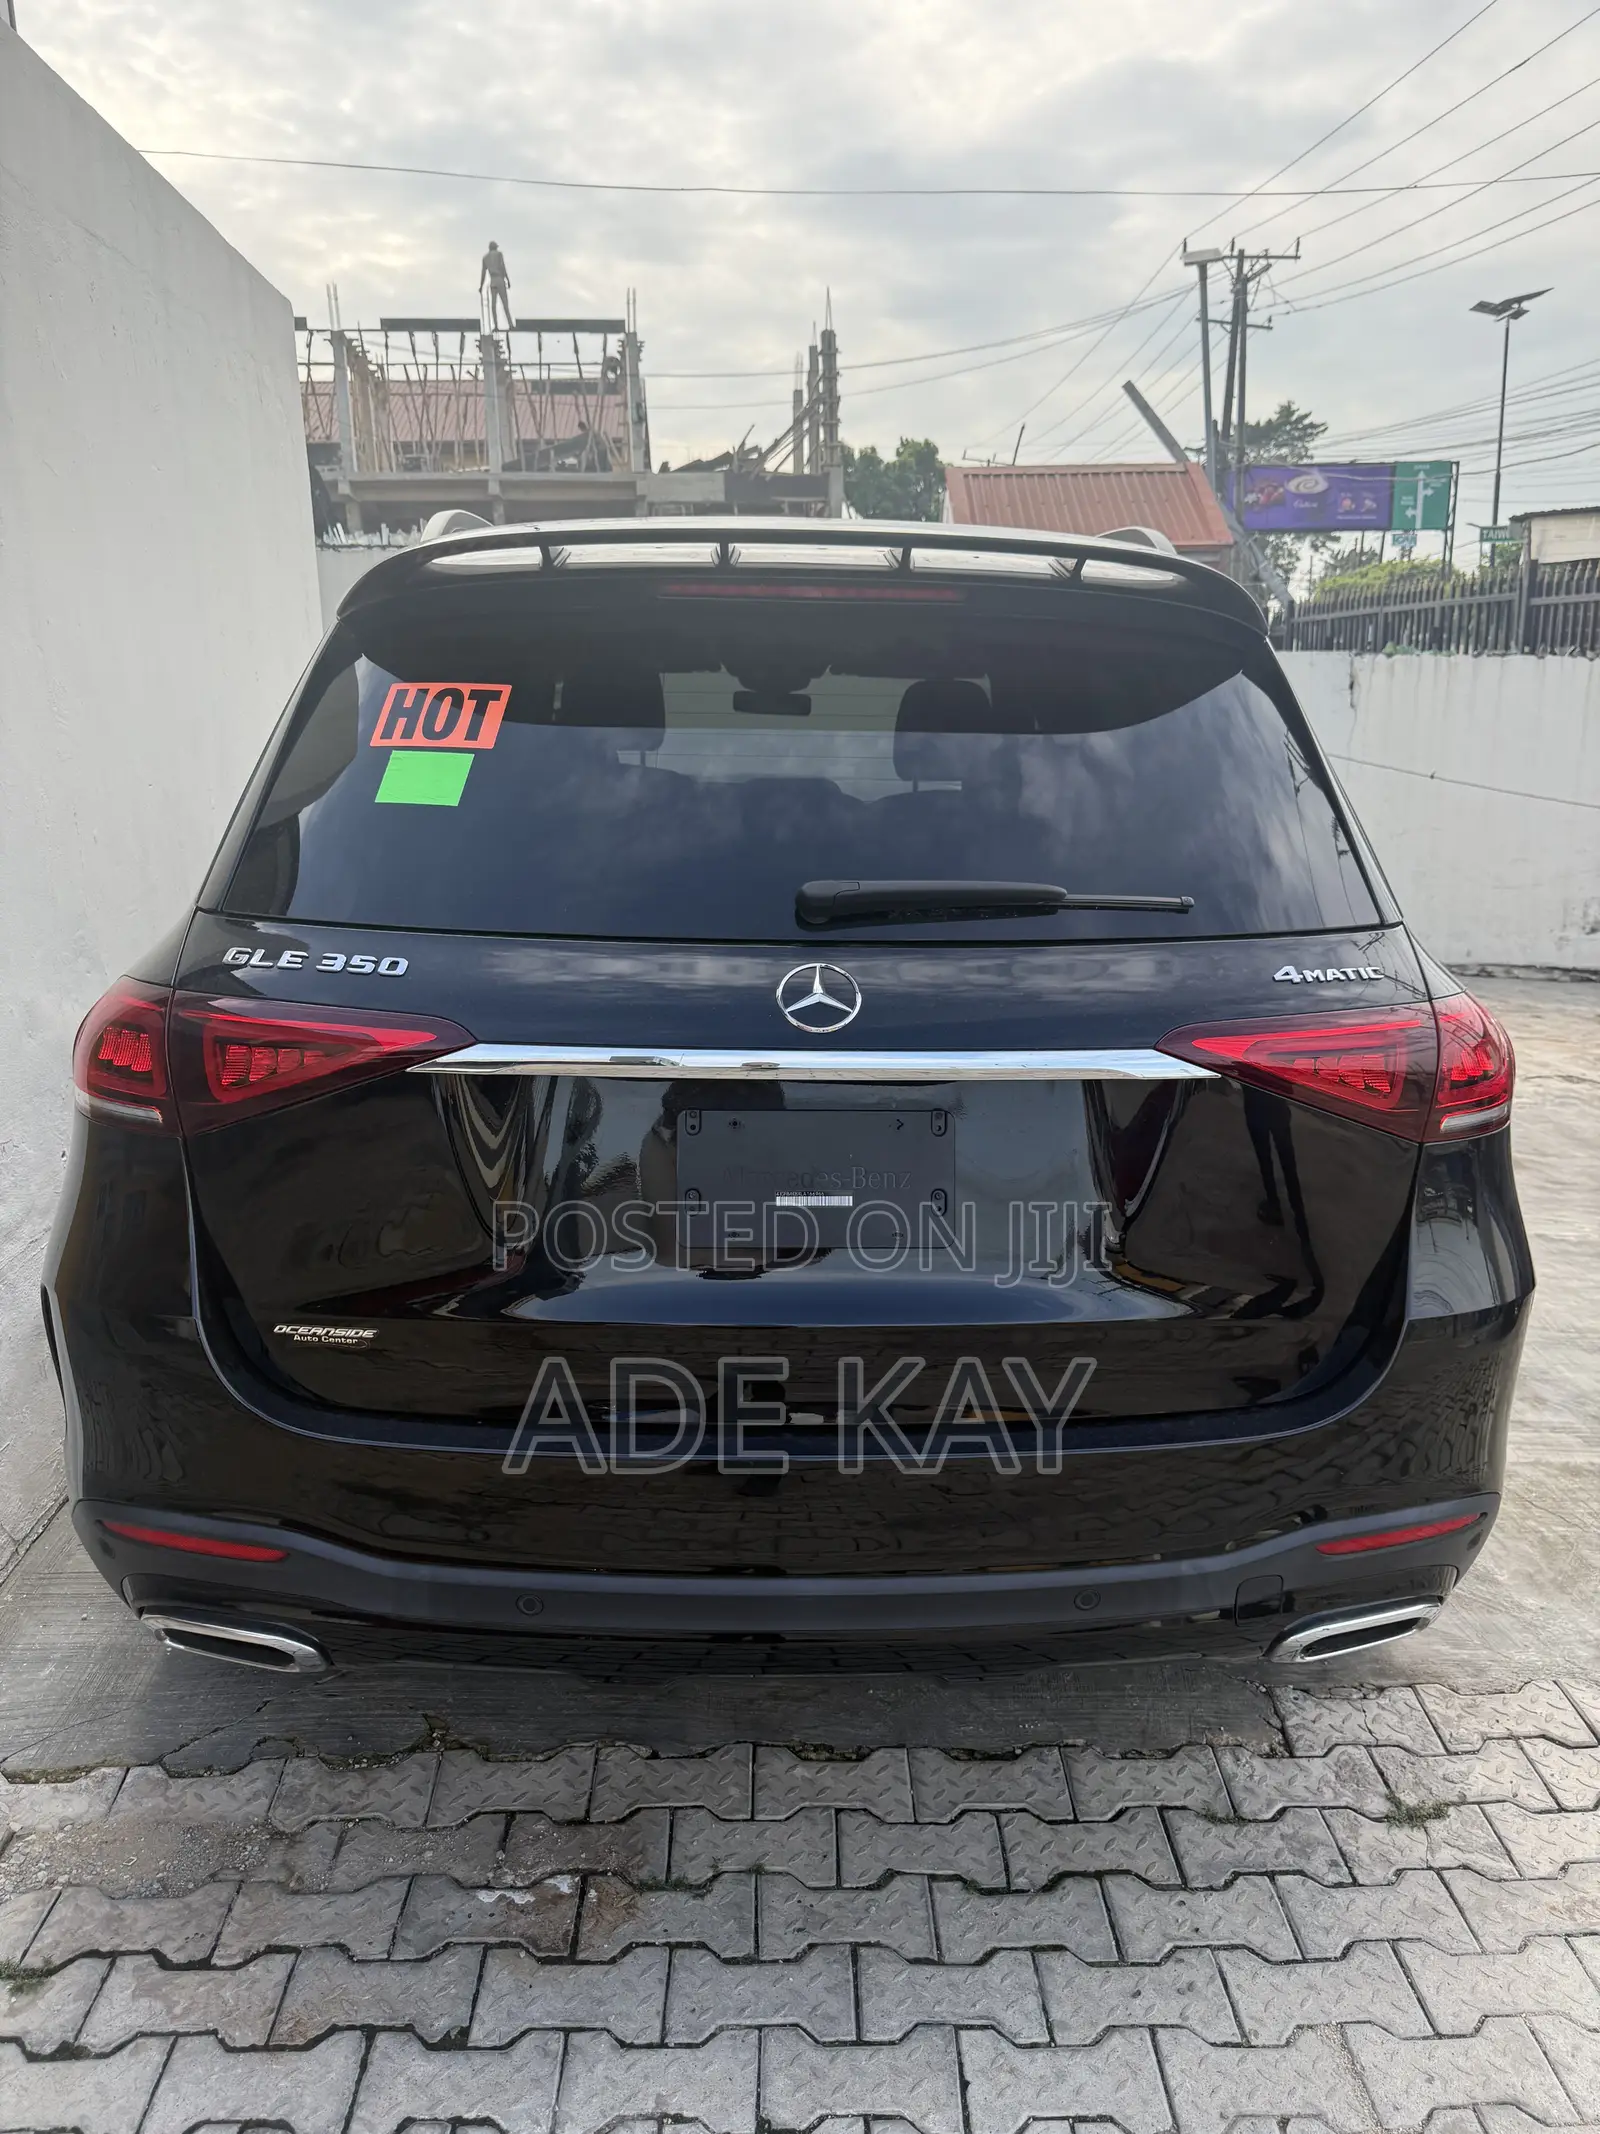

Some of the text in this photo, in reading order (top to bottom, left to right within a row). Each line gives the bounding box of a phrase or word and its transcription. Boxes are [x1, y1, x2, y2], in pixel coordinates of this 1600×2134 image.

[379, 687, 504, 742] HOT
[221, 946, 409, 977] GLE 350
[1273, 965, 1385, 984] 4MATIC
[273, 1324, 378, 1338] OCEANSIDE
[293, 1334, 358, 1344] Auto Center
